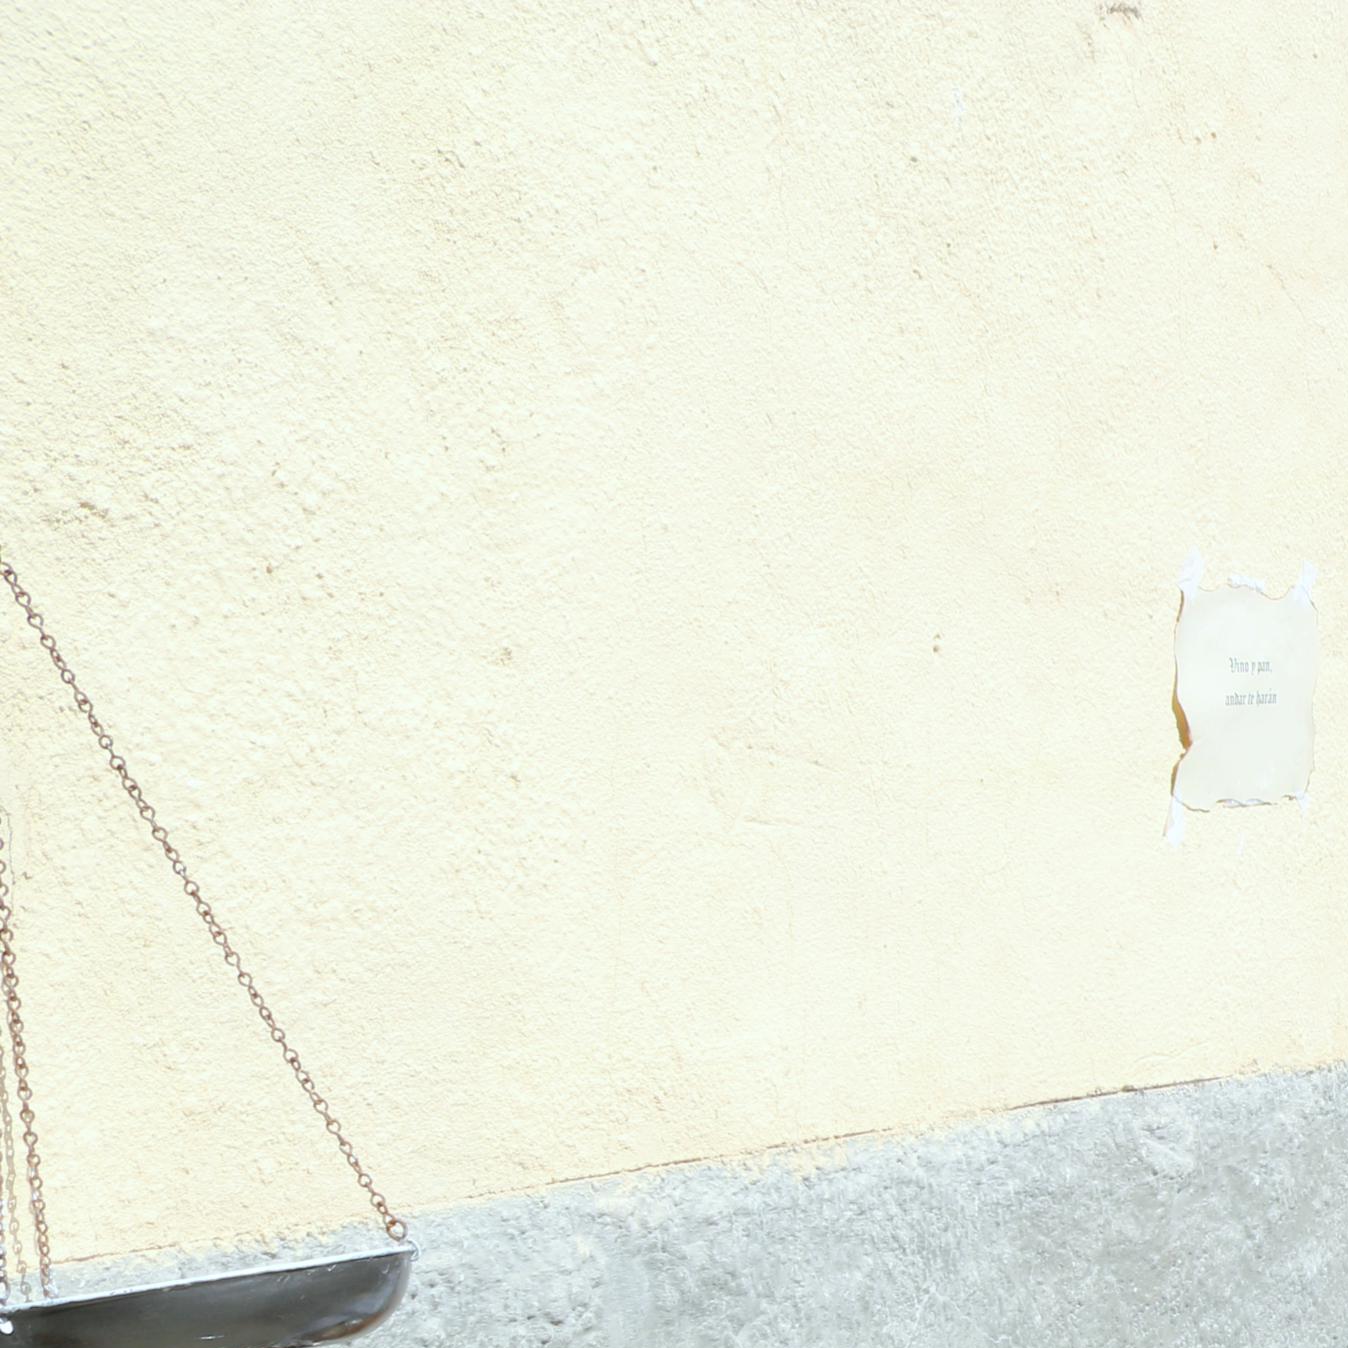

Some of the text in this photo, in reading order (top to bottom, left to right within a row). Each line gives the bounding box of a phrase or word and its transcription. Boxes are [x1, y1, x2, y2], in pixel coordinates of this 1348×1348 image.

[1229, 656, 1249, 673] Vino
[1257, 661, 1273, 675] pan,
[1225, 691, 1247, 706] andar
[1247, 692, 1255, 705] te
